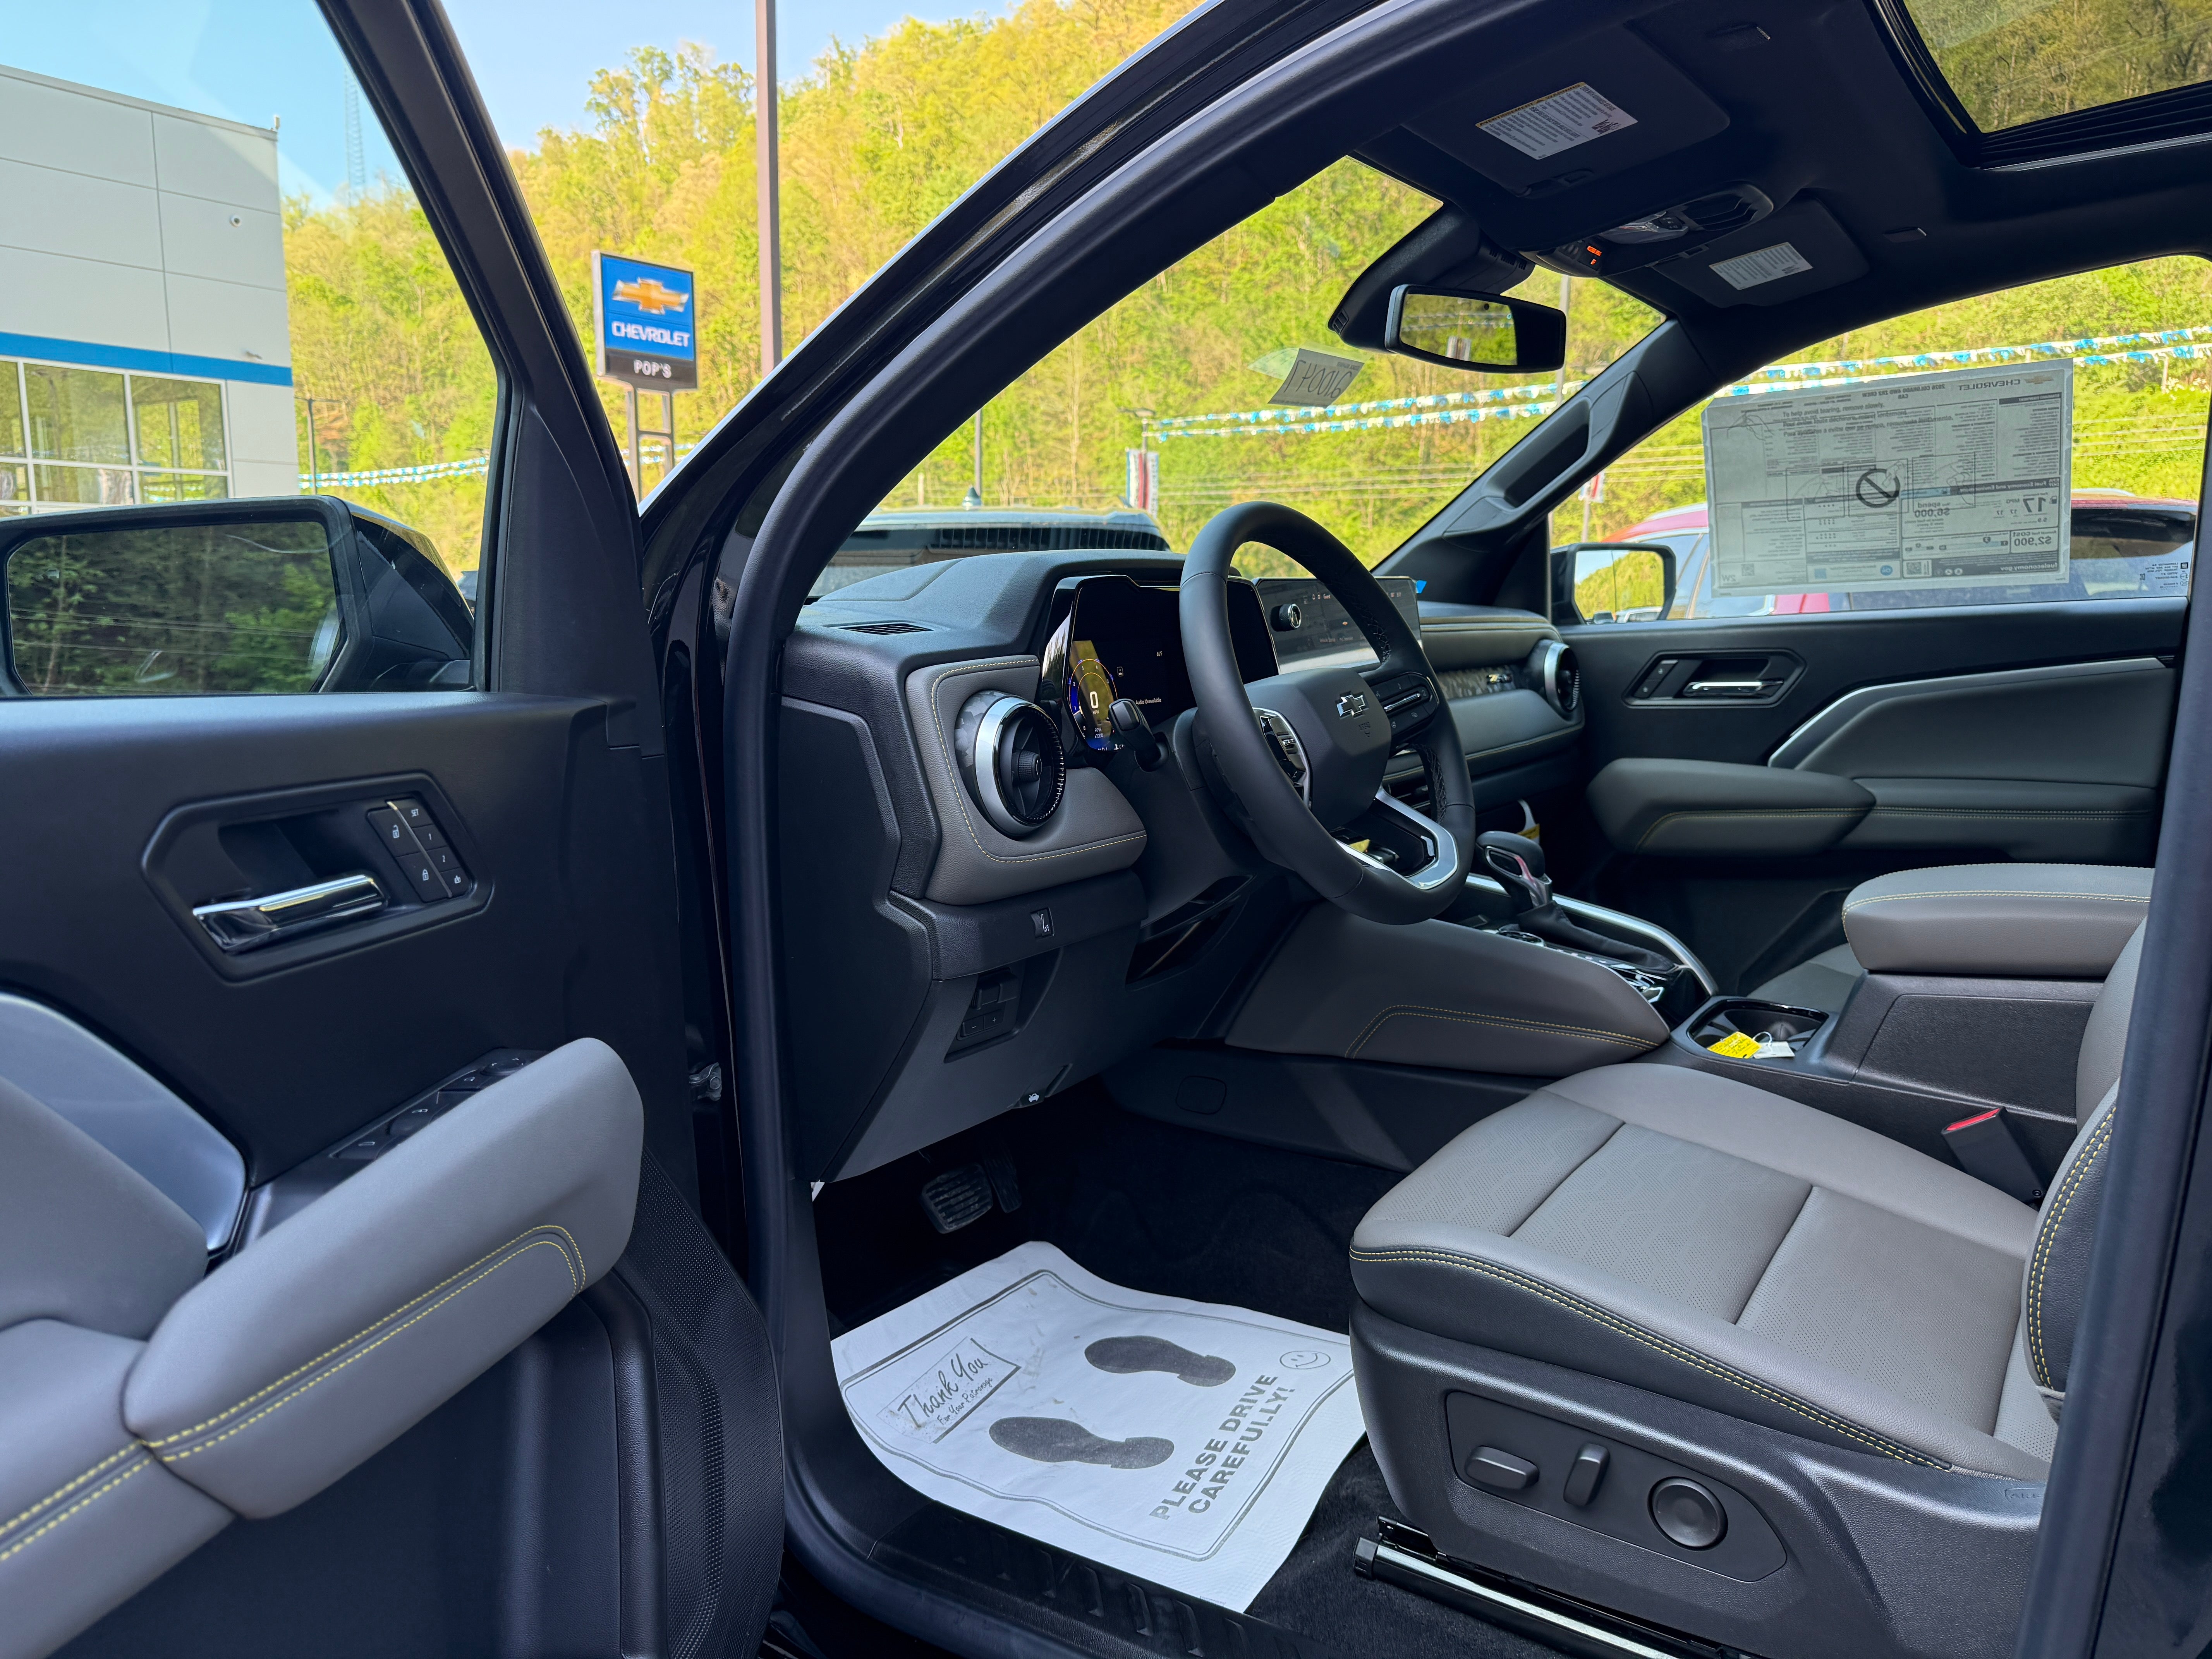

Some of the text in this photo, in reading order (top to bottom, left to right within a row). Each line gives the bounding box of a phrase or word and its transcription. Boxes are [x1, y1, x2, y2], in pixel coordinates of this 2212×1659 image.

[611, 321, 690, 347] CHEVROLET
[634, 359, 672, 378] POP'S
[1089, 691, 1099, 709] 0
[897, 1353, 988, 1428] Thank You
[937, 1377, 993, 1425] For Your Patronage
[1149, 1375, 1278, 1520] PLEASE DRIVE
[1188, 1387, 1296, 1514] CAREFULLY!
